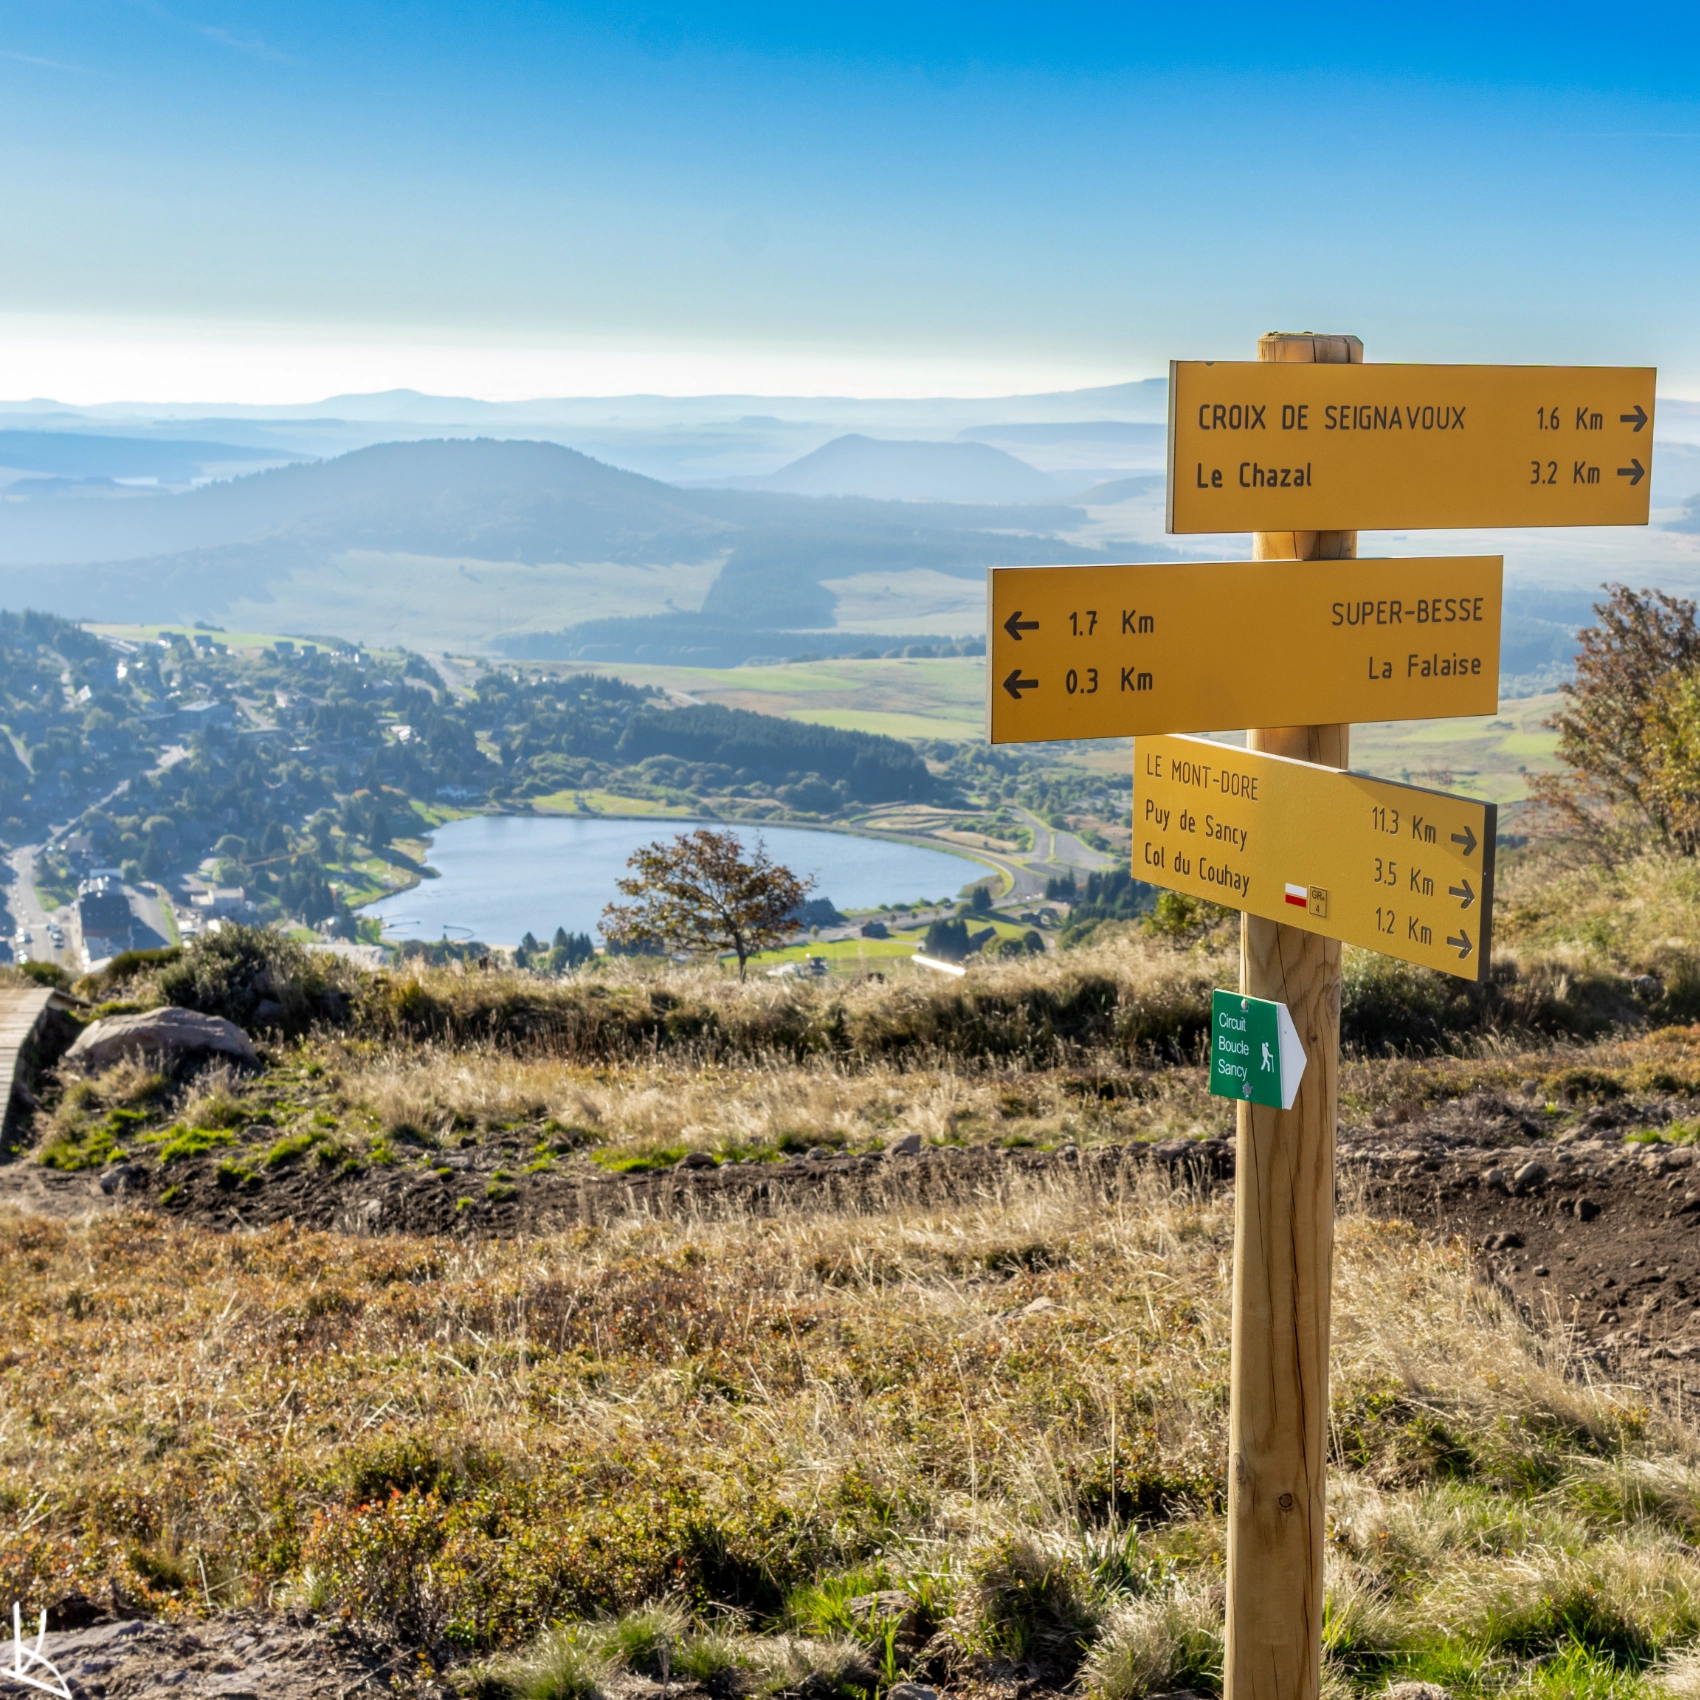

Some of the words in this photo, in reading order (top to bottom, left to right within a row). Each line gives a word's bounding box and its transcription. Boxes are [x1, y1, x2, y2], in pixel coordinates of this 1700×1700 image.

[1199, 404, 1265, 430] CROIX
[1282, 405, 1308, 430] DE
[1325, 406, 1465, 430] SEIGNAVOUX
[1537, 407, 1559, 430] 1.6
[1576, 407, 1602, 430] Km
[1197, 463, 1223, 488] Le
[1240, 463, 1311, 487] Chazal
[1531, 461, 1557, 484] 3.2
[1574, 461, 1600, 484] Km
[1070, 611, 1097, 636] 1.7
[1123, 610, 1153, 634] Km
[1332, 598, 1483, 626] SUPER-BESSE
[1066, 669, 1098, 694] 0.3
[1121, 667, 1152, 691] Km
[1369, 657, 1392, 679] La
[1408, 653, 1481, 677] Falaise
[1147, 754, 1161, 777] LE
[1172, 759, 1258, 800] MONT-DORE
[1373, 807, 1399, 834] 11.3
[1413, 815, 1436, 844] Km
[1146, 799, 1170, 831] Puy
[1180, 809, 1195, 832] de
[1206, 815, 1247, 852] Sancy
[1374, 858, 1396, 886] 3.5
[1411, 867, 1433, 896] Km
[1145, 842, 1164, 868] Col
[1175, 851, 1190, 875] du
[1199, 858, 1250, 898] Couhay
[1376, 907, 1395, 934] 1.2
[1409, 916, 1431, 945] Km
[1218, 1012, 1247, 1032] Circuit
[1218, 1035, 1249, 1056] Boucle
[1217, 1059, 1248, 1082] Sancy
